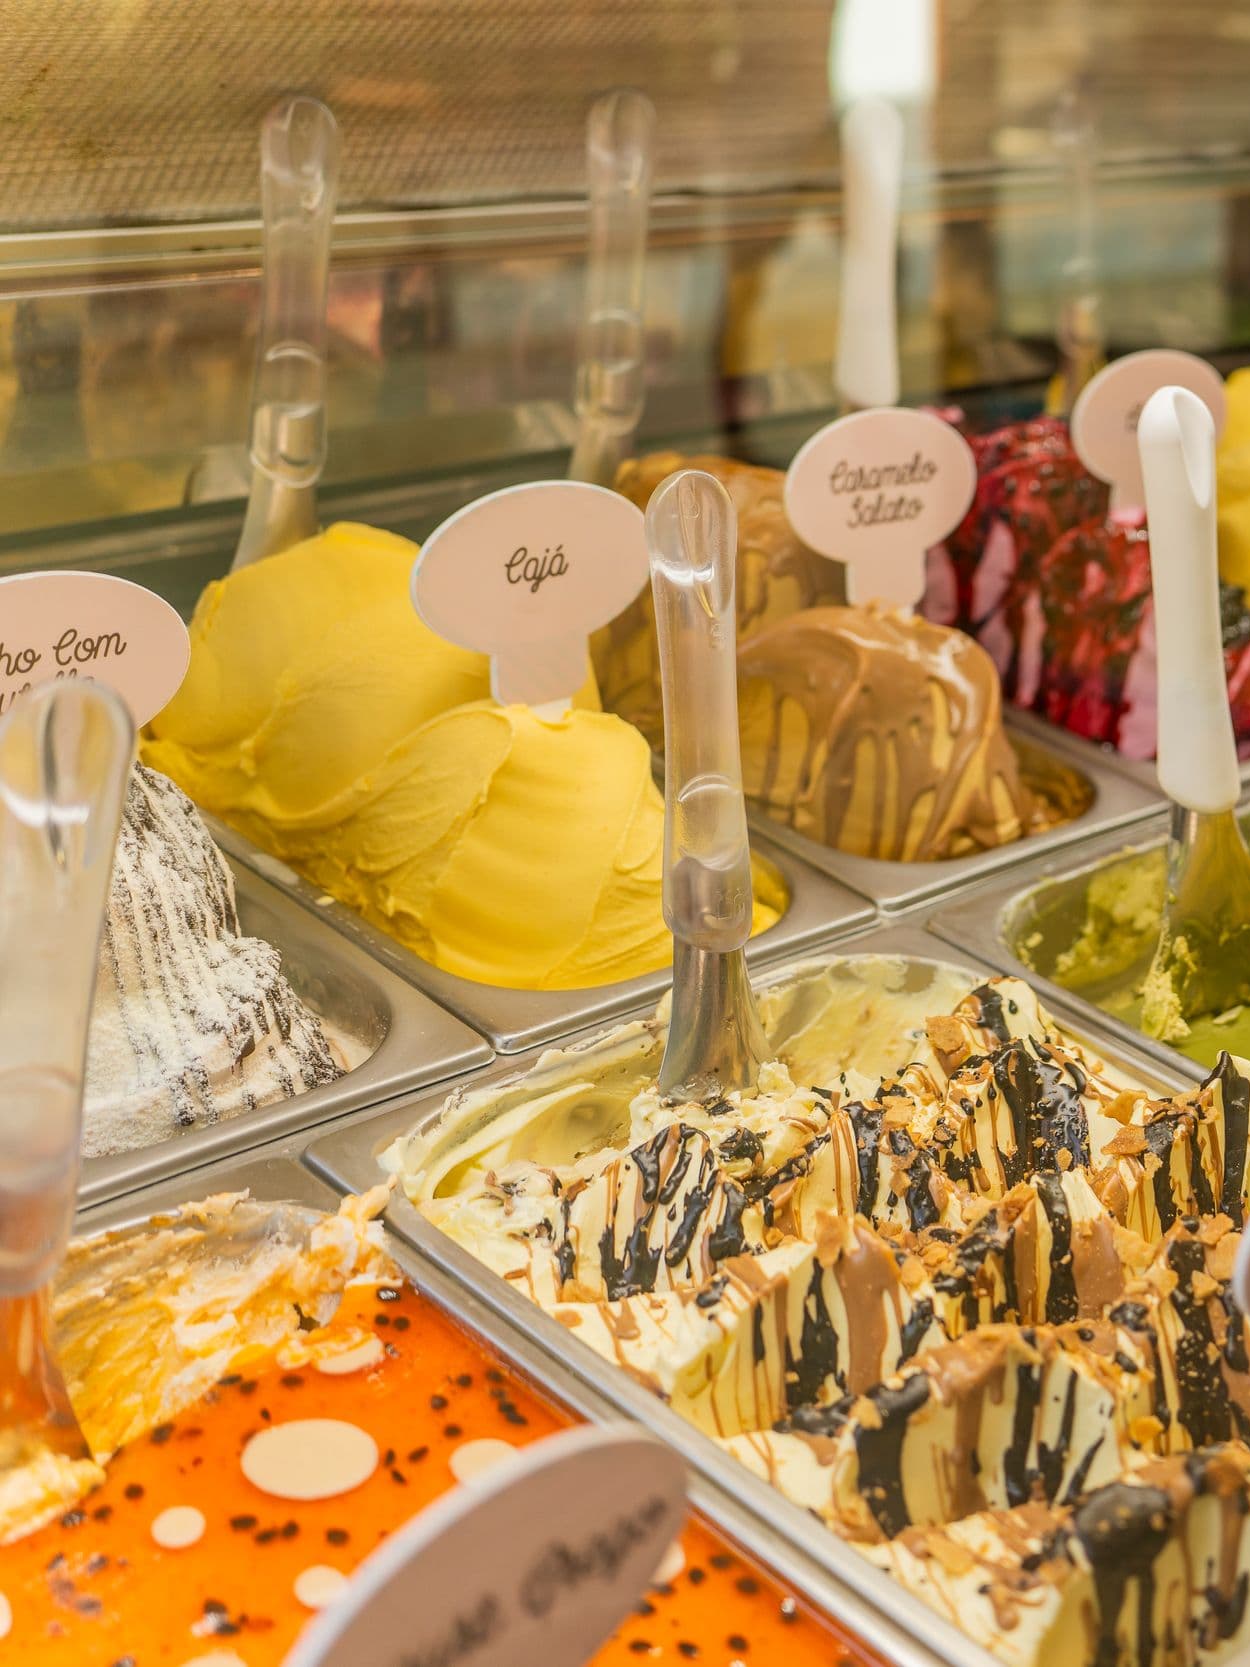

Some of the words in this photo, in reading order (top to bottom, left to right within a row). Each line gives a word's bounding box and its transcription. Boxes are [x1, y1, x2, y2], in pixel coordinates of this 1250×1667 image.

[829, 451, 937, 495] Caramelo
[847, 492, 924, 528] Salato
[504, 539, 569, 593] Cajá
[52, 629, 127, 666] Com
